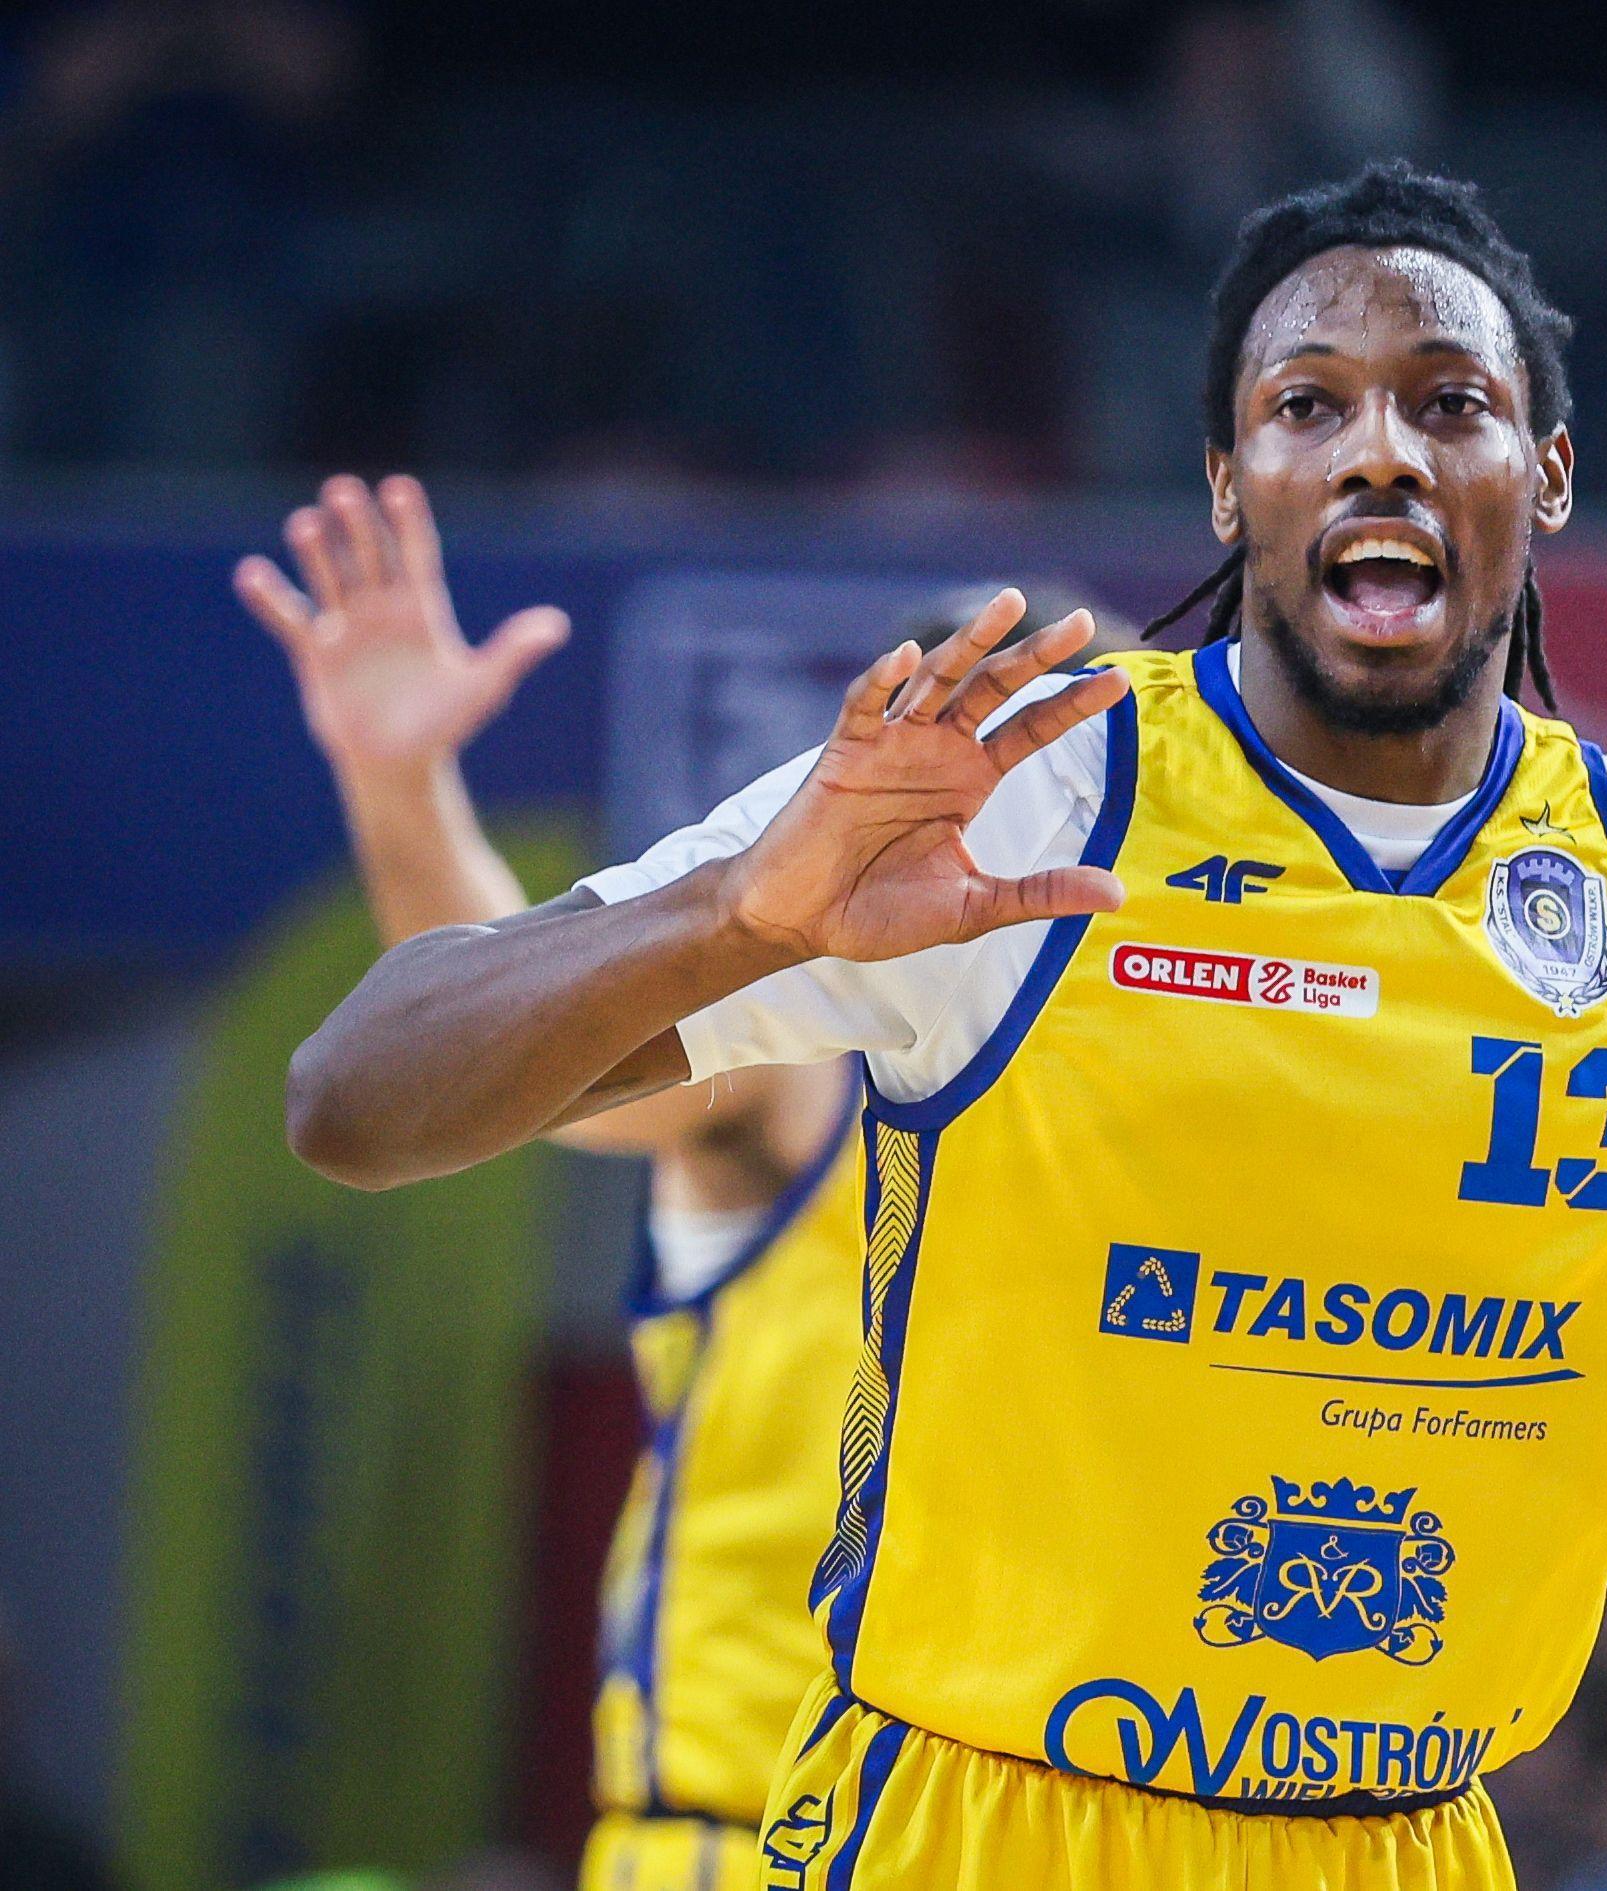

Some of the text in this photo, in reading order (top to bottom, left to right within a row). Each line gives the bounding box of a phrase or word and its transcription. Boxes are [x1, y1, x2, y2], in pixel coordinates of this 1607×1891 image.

[1166, 855, 1286, 904] 4F
[1123, 954, 1240, 992] ORLEN
[1303, 968, 1367, 990] Basket
[1543, 964, 1577, 976] 1947
[1303, 988, 1341, 1008] Liga
[1210, 1271, 1582, 1360] TASOMIX
[1321, 1399, 1548, 1441] Grupa ForFarmers
[1262, 1711, 1496, 1789] OSTRÓW
